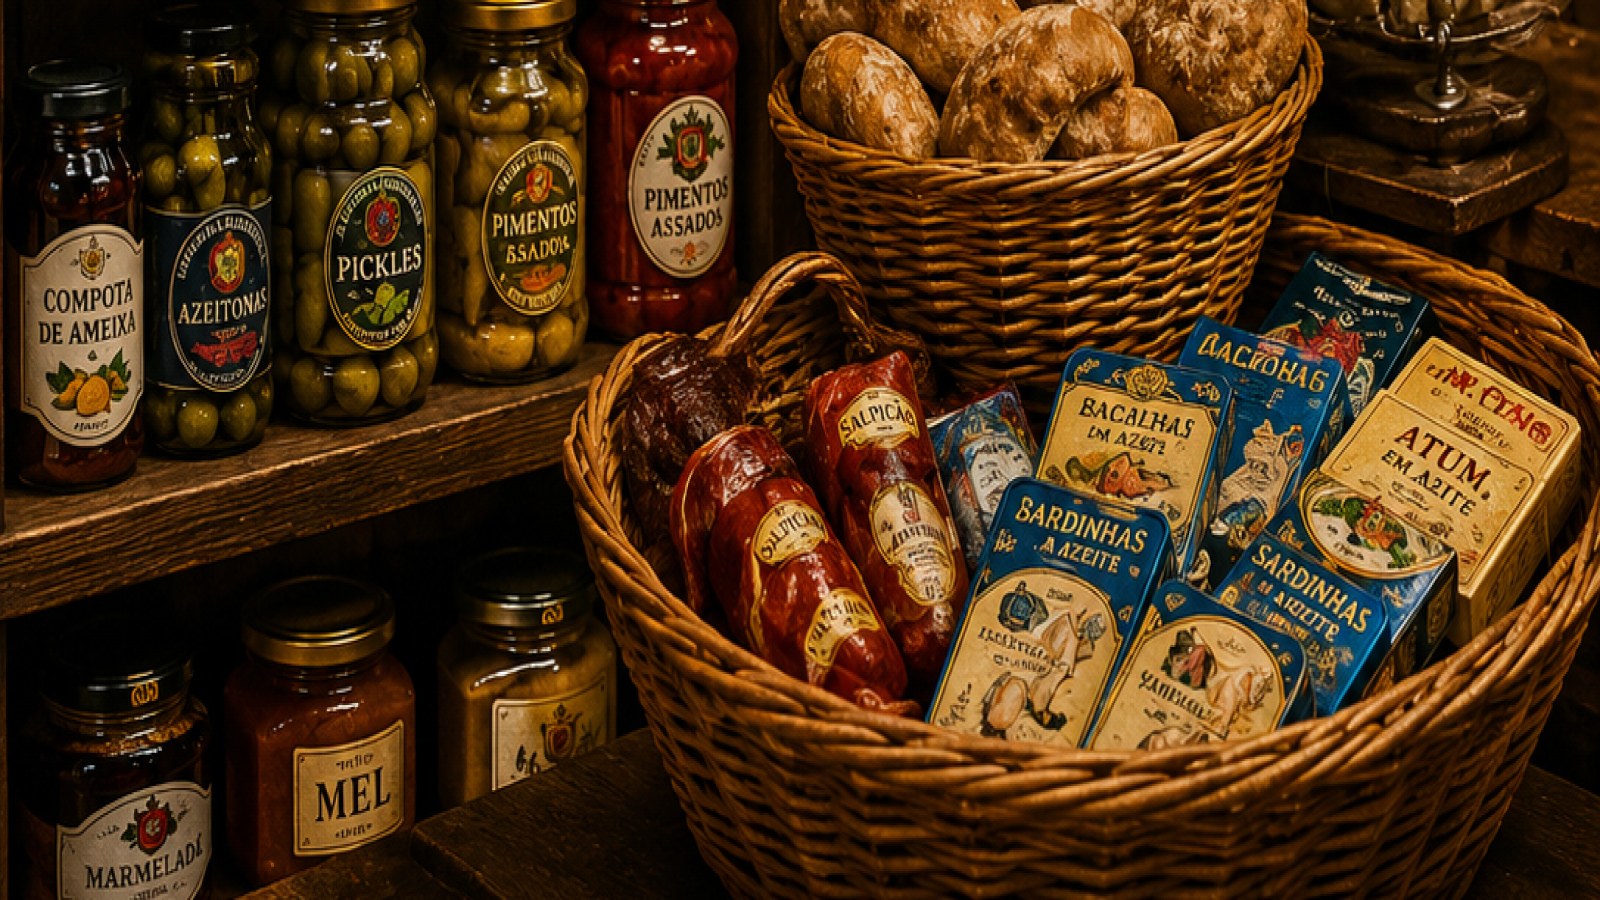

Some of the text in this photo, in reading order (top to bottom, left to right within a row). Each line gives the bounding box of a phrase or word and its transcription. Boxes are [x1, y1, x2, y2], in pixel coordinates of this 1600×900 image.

[644, 175, 729, 212] PIMENTOS
[492, 200, 577, 238] PIMENTOS
[335, 243, 422, 283] PICKLES
[43, 278, 133, 314] COMPOTA
[177, 287, 268, 325] AZEITONAS
[39, 309, 136, 345] DE AMEIXA
[1078, 397, 1196, 439] BACALHAS
[1251, 544, 1372, 634] SARDINHAS
[315, 766, 391, 822] MEL
